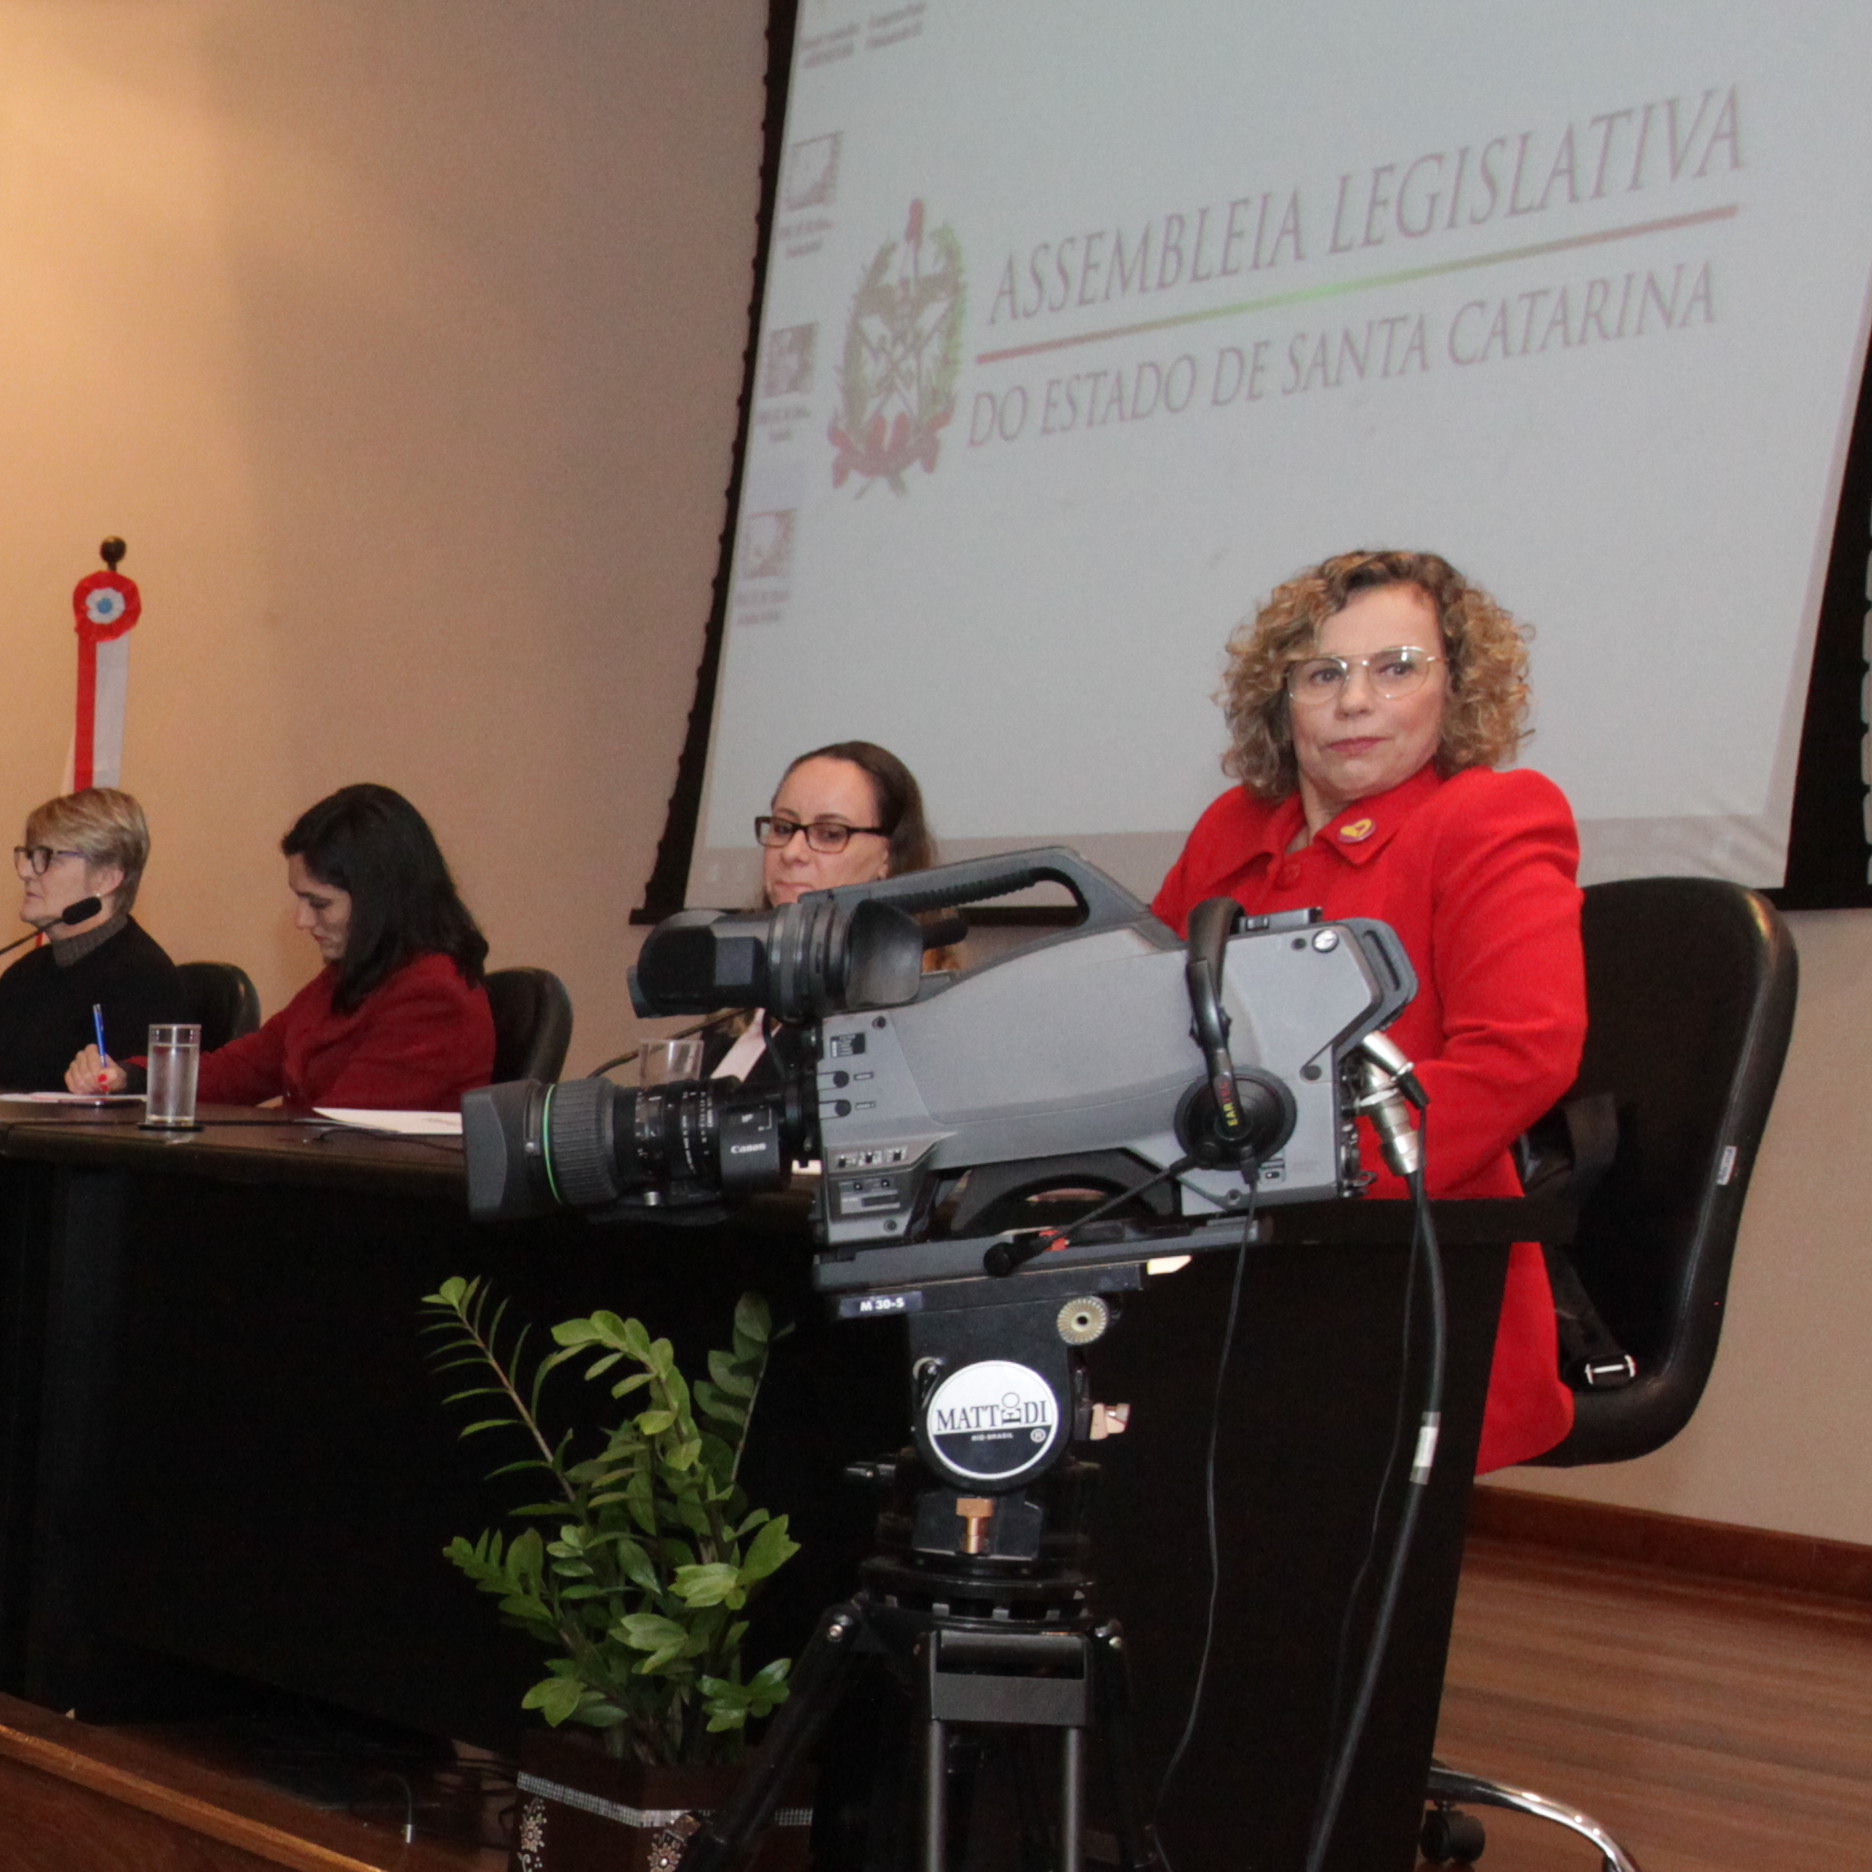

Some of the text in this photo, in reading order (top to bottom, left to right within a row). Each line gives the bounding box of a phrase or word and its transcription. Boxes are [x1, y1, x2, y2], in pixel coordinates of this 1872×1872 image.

[987, 83, 1745, 324] ASSEMBLEIA LEGISLATIVA
[968, 259, 1715, 446] DO ESTADO DE SANTA CATARINA
[730, 1143, 767, 1154] Canon
[860, 1301, 873, 1312] M
